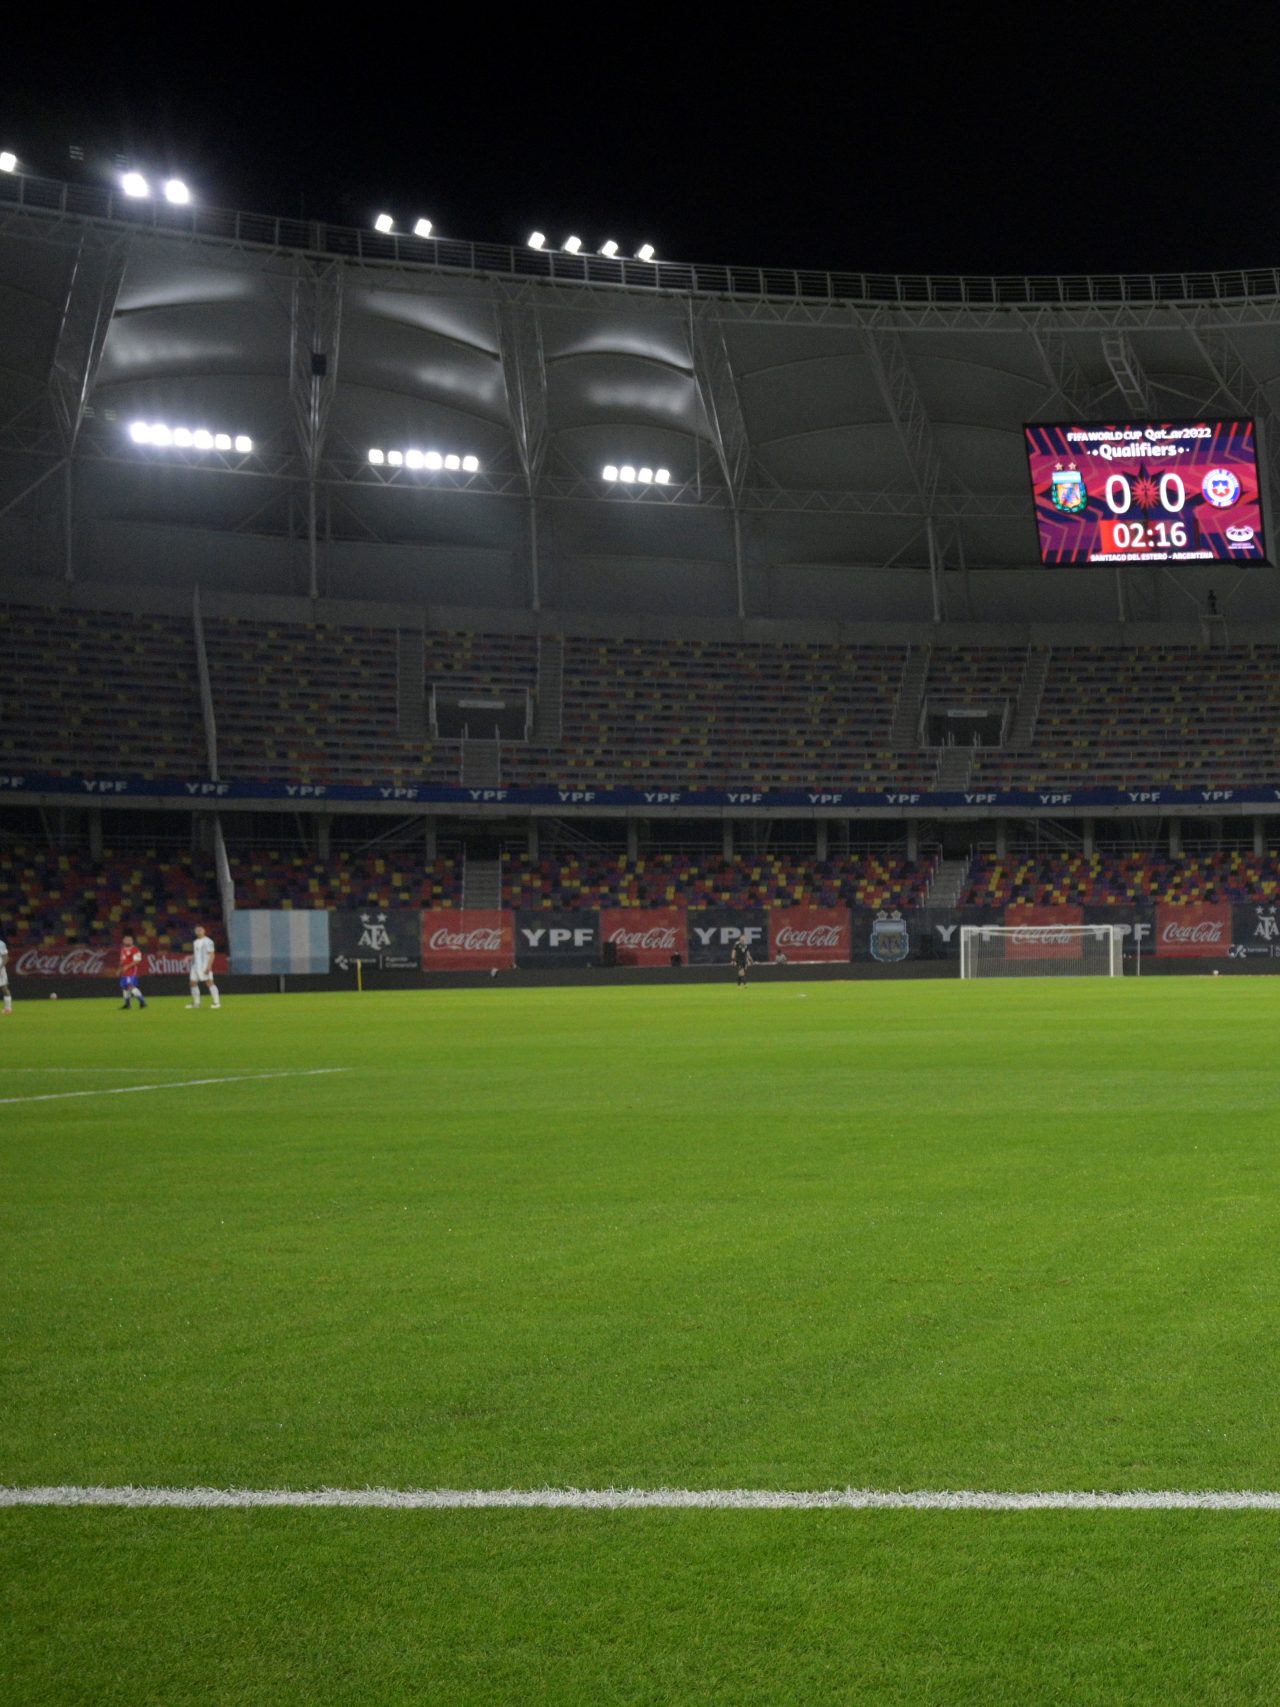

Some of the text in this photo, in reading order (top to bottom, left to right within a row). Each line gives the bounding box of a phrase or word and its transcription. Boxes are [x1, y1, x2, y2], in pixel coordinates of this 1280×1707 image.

[1066, 432, 1090, 442] FIFA
[1090, 430, 1123, 441] WORLD
[1124, 430, 1142, 440] CUP
[1100, 442, 1177, 460] Qualifiers
[1106, 474, 1131, 514] 0
[1160, 472, 1185, 513] 0
[1113, 521, 1187, 548] 02:16
[1090, 553, 1126, 562] SANTIAGO
[1127, 553, 1142, 561] DEL
[1142, 552, 1168, 561] ESTERO
[1172, 551, 1214, 560] ARGENTINA
[0, 777, 25, 788] PF
[84, 780, 128, 792] YPF
[186, 783, 230, 795] YPF
[285, 786, 326, 797] YPF
[380, 788, 419, 799] YPF
[469, 790, 508, 801] YPF
[558, 792, 595, 802] YPF
[644, 793, 680, 803] YPF
[727, 794, 762, 804] YPF
[808, 794, 843, 804] YPF
[886, 794, 920, 804] YPF
[964, 794, 997, 804] YPF
[1040, 794, 1072, 804] YPF
[1129, 792, 1161, 802] YPF
[1201, 791, 1234, 801] YPF
[936, 924, 1001, 942] YPF
[1163, 921, 1223, 943] Coca-Cola
[1254, 915, 1280, 941] AFA
[358, 922, 391, 950] AFA
[430, 927, 504, 951] Coca-Cola
[521, 929, 594, 947] YPF
[609, 927, 680, 950] Coca-Cola
[694, 927, 763, 945] YPF
[776, 926, 843, 947] Coca-Cola
[15, 948, 108, 975] Coca-Cola
